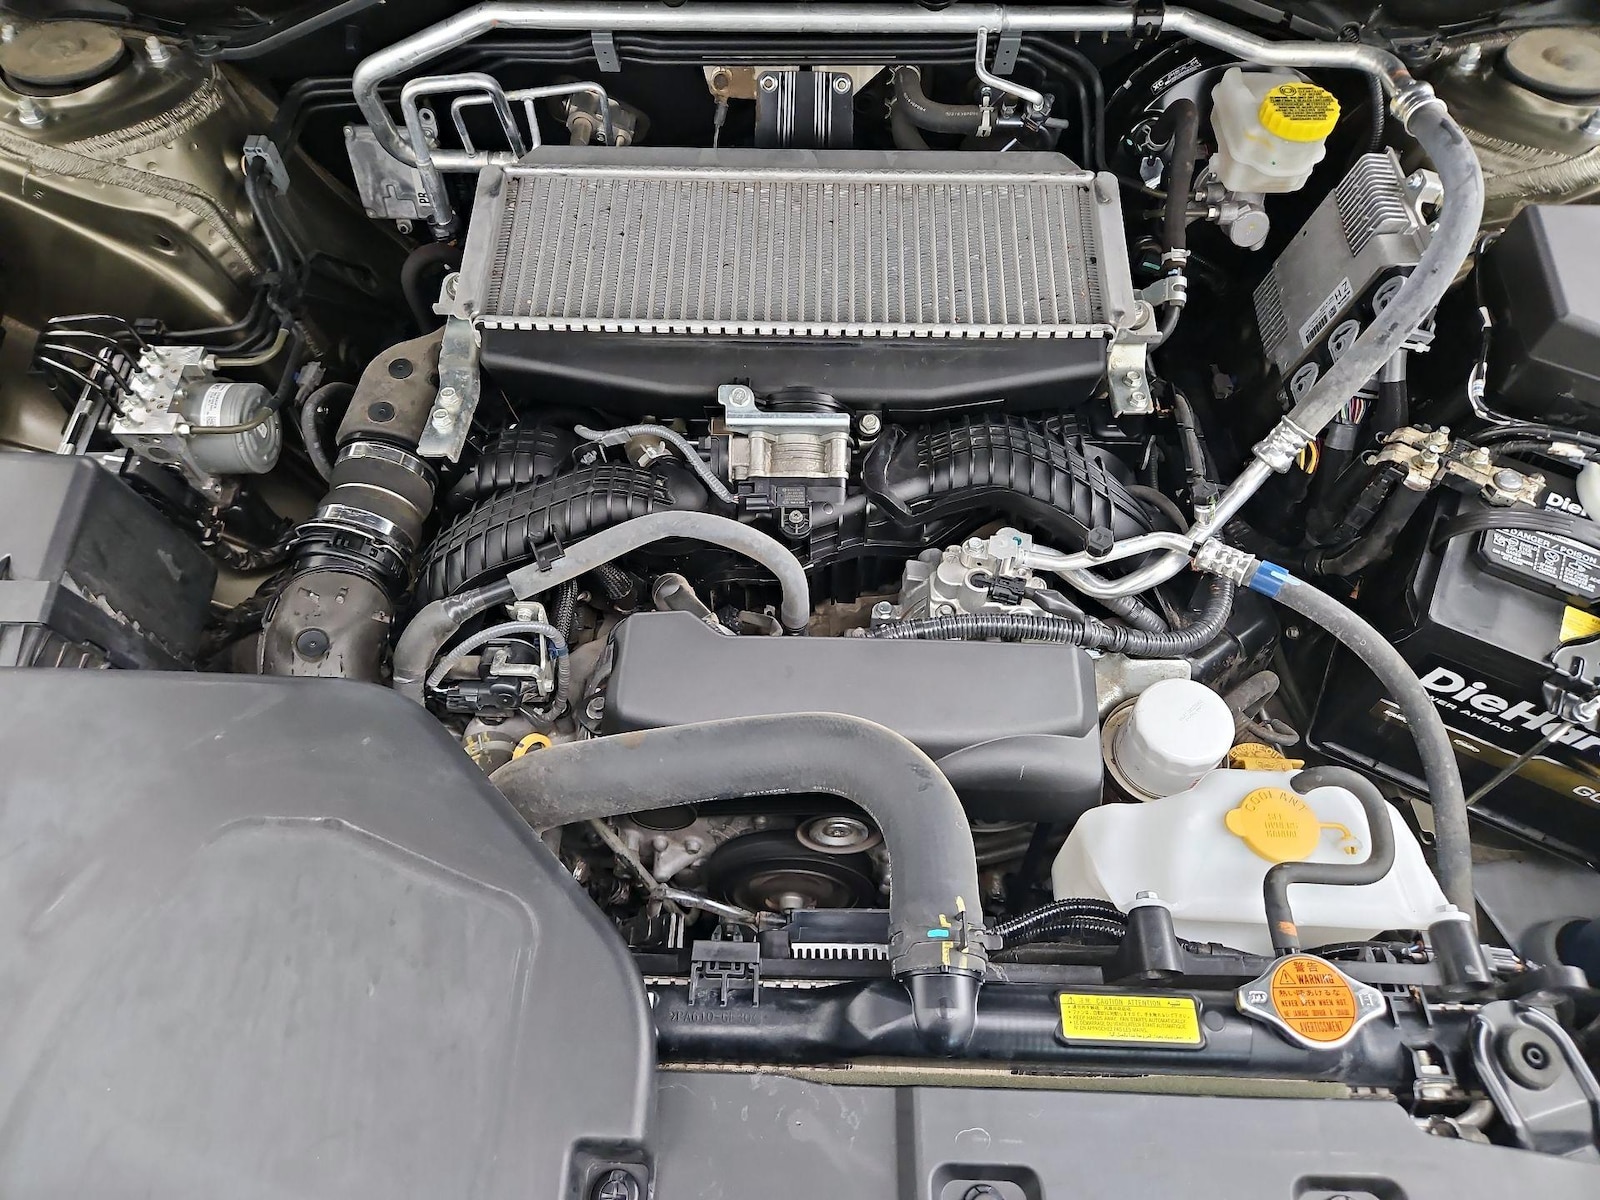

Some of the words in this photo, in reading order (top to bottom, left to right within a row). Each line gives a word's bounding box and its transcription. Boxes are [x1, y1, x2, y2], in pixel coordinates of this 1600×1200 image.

[1510, 529, 1551, 548] DANGER
[1560, 546, 1598, 565] POISON
[1427, 696, 1458, 711] WER
[1459, 710, 1515, 732] AHEAD
[1245, 790, 1308, 812] COOLANT
[1296, 974, 1335, 984] WARNING
[1096, 998, 1123, 1006] CAUTION
[1127, 998, 1162, 1007] ATTENTION
